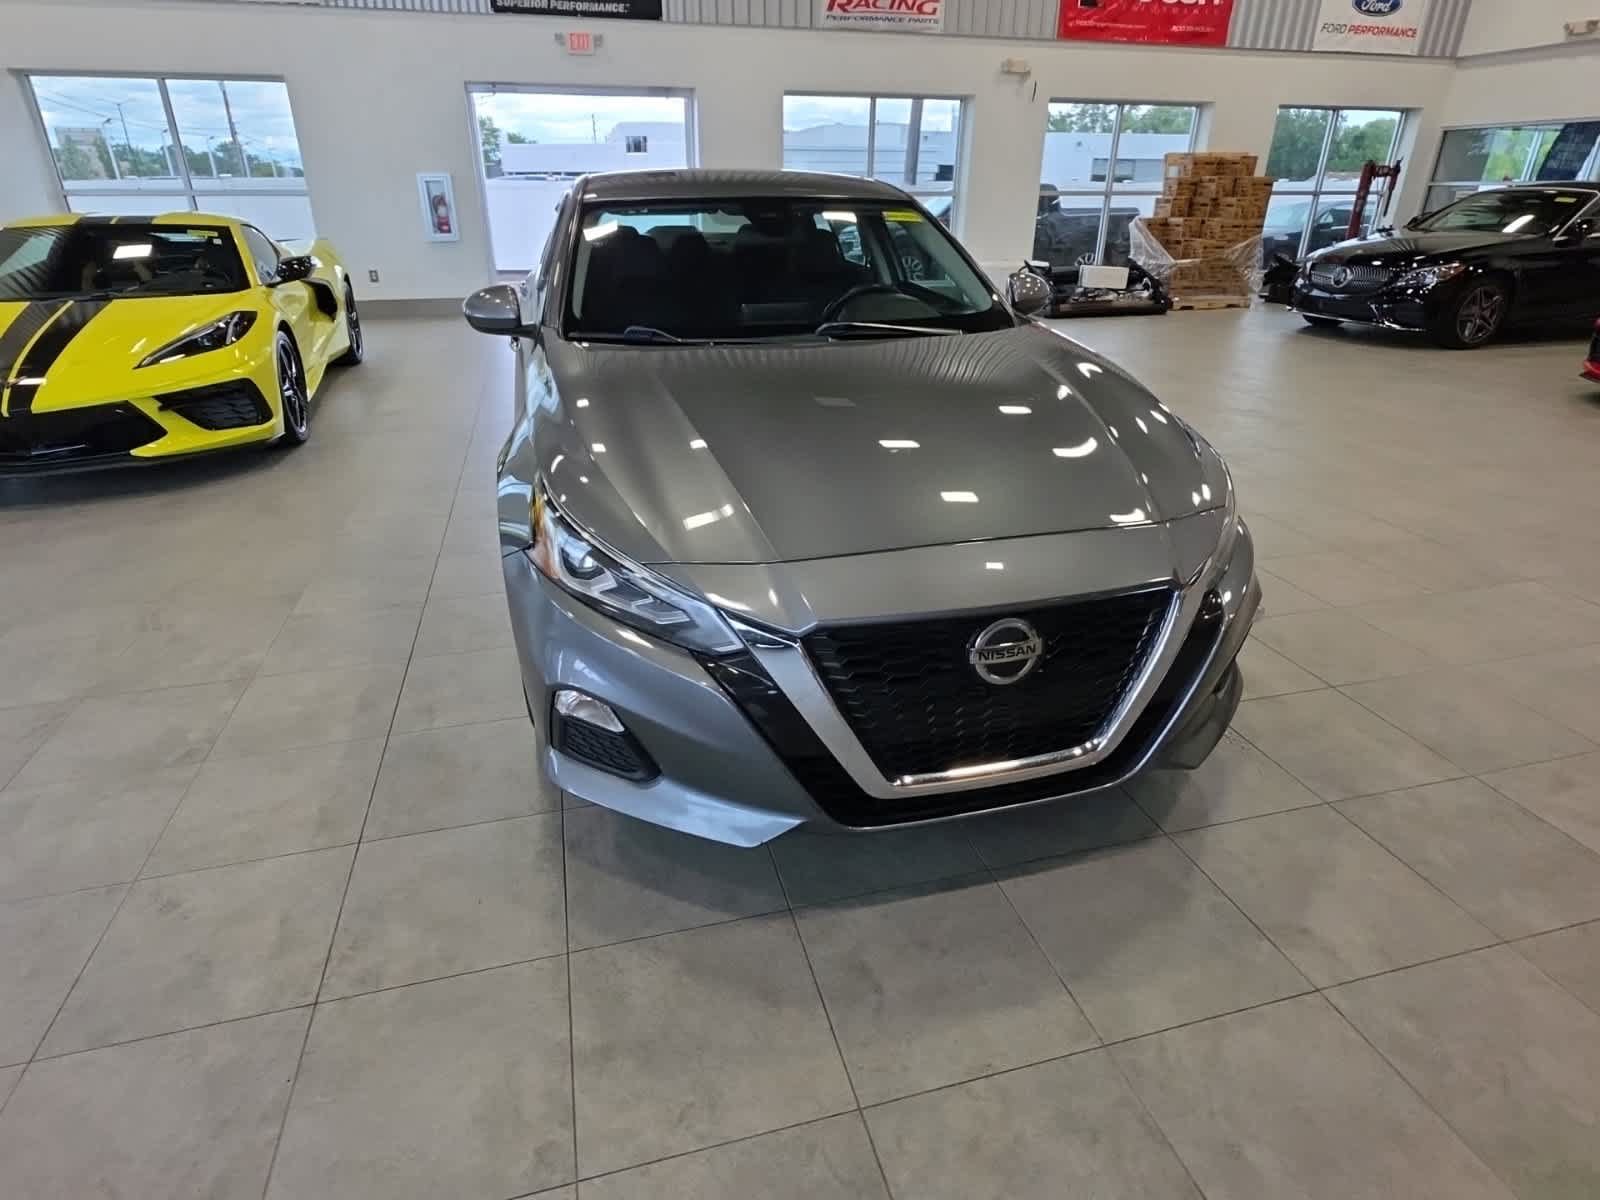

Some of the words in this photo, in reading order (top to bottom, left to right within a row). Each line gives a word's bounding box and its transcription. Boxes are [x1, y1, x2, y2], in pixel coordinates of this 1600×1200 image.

[826, 0, 939, 15] RACING
[1320, 23, 1347, 34] FORD
[1348, 25, 1418, 38] PERFORMANCE
[978, 644, 1037, 661] NISSAN
